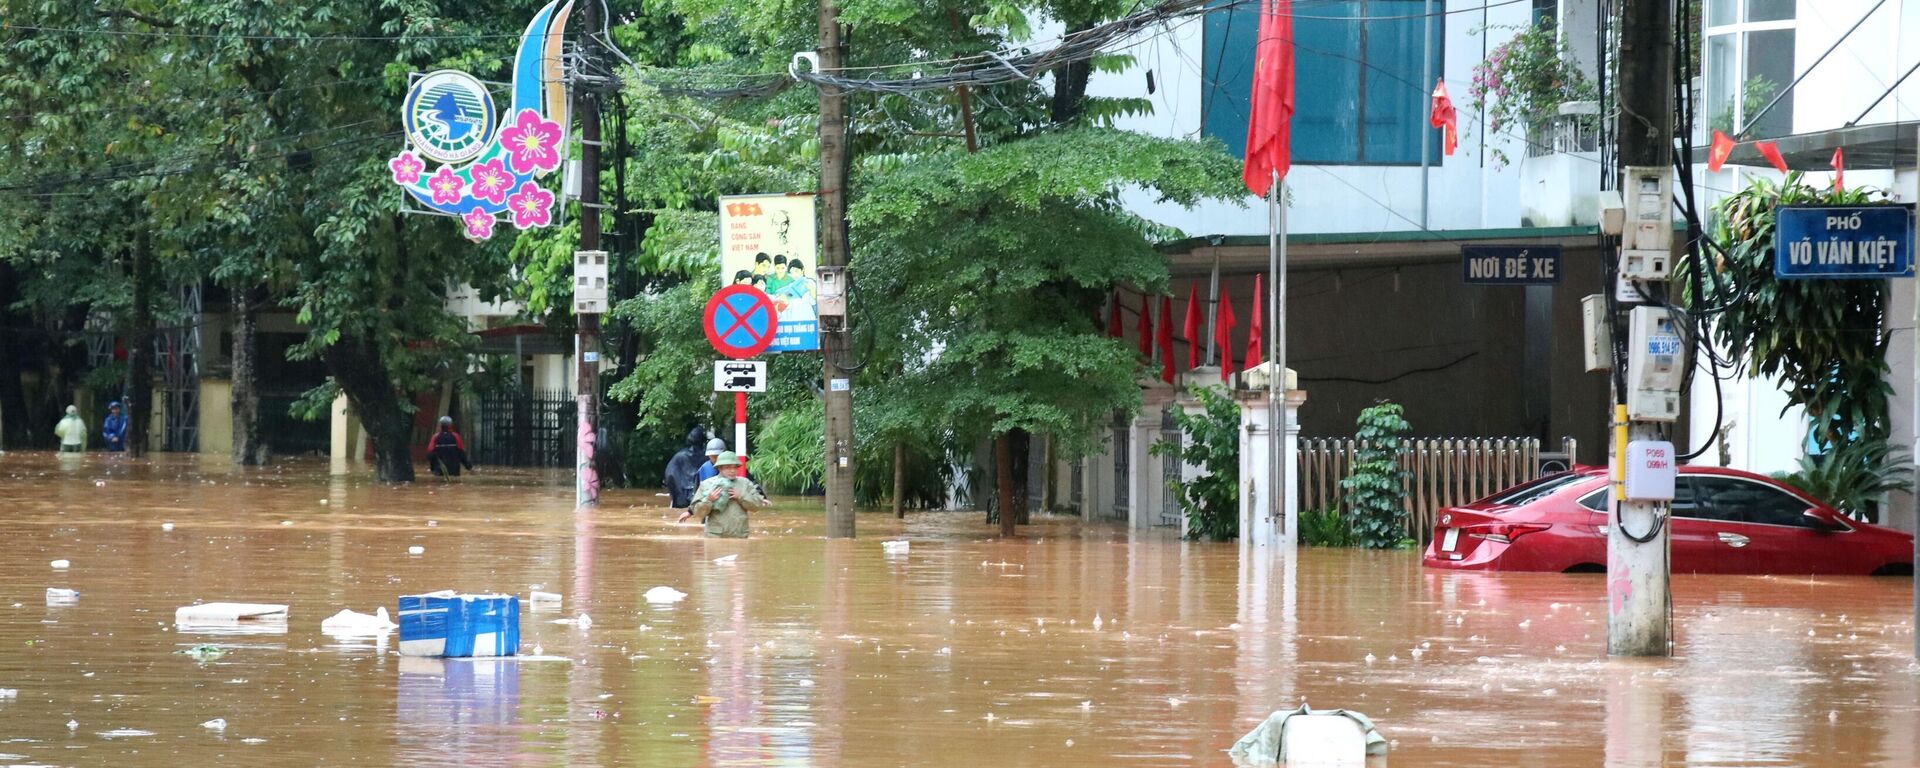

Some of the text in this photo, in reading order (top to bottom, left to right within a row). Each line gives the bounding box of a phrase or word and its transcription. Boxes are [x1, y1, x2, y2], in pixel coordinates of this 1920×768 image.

[1826, 211, 1862, 230] PHỐ
[745, 243, 759, 251] NAM
[1789, 235, 1897, 269] VÕ VĂN KIỆT
[1469, 249, 1554, 278] NƠI ĐỂ XE
